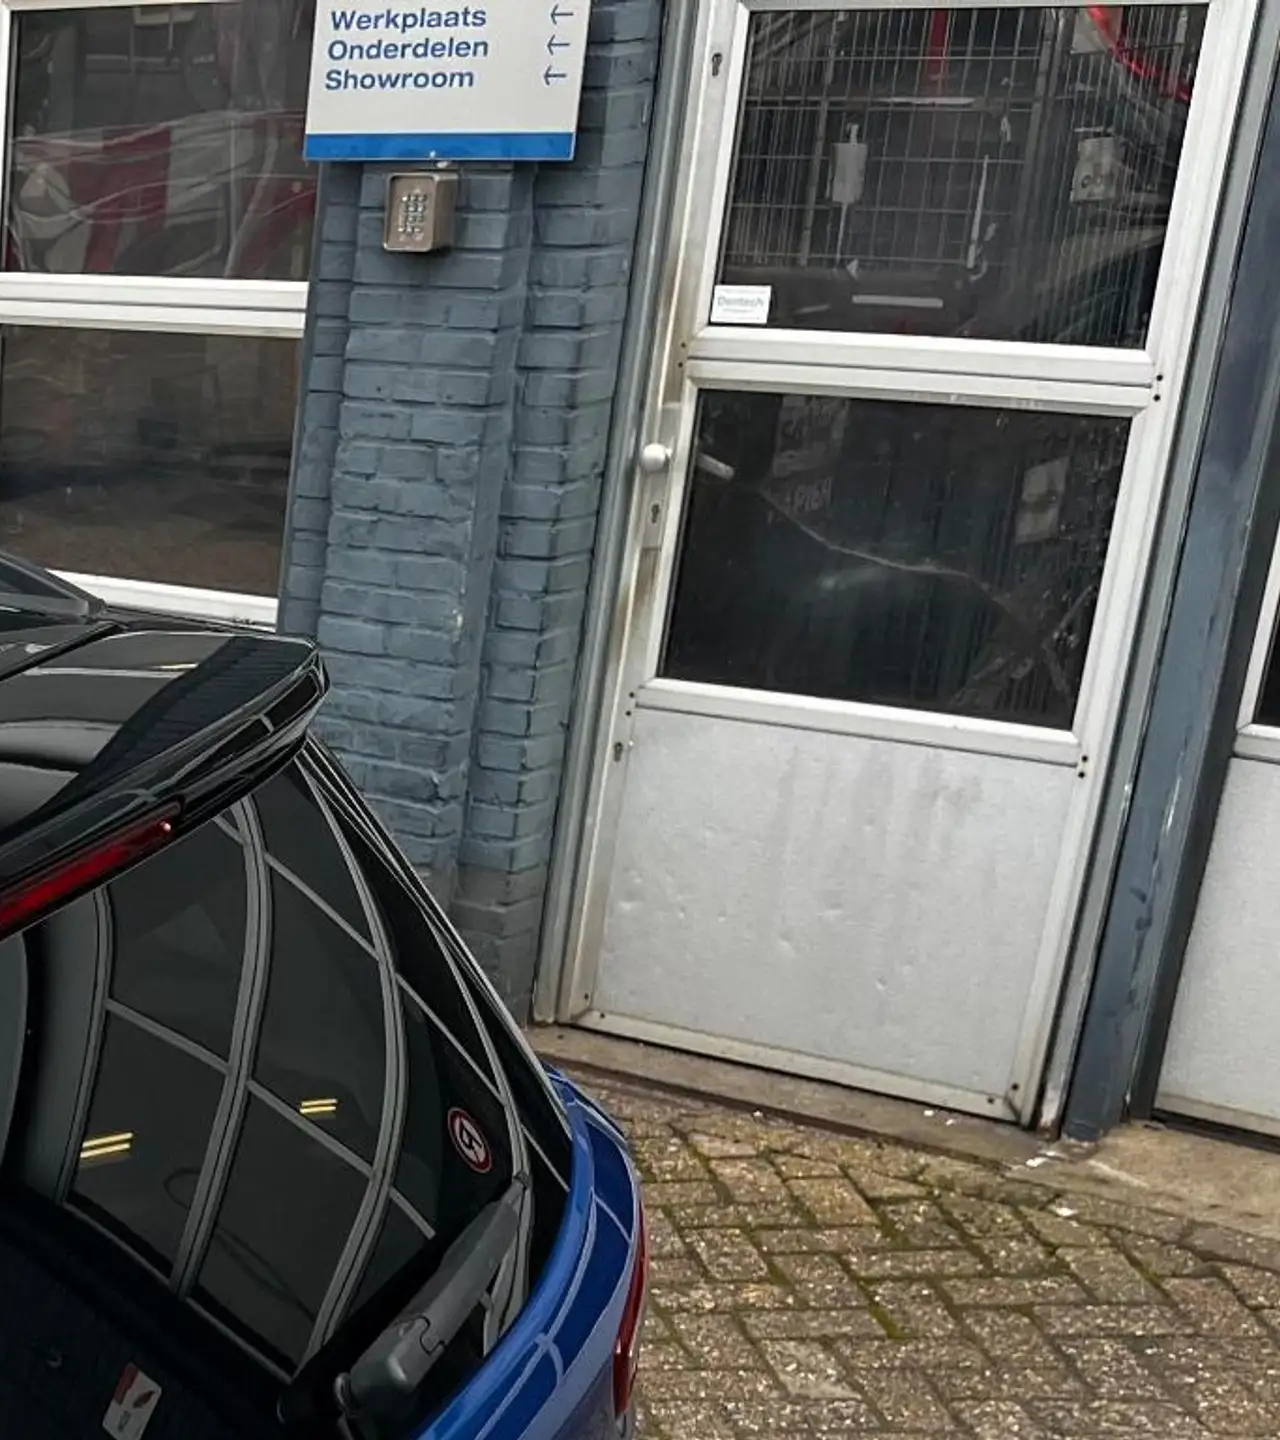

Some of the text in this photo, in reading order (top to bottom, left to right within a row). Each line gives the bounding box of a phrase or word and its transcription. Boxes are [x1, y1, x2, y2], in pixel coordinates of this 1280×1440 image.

[330, 6, 488, 34] Werkplaats
[327, 36, 489, 61] Onderdelen
[324, 68, 475, 91] Showroom
